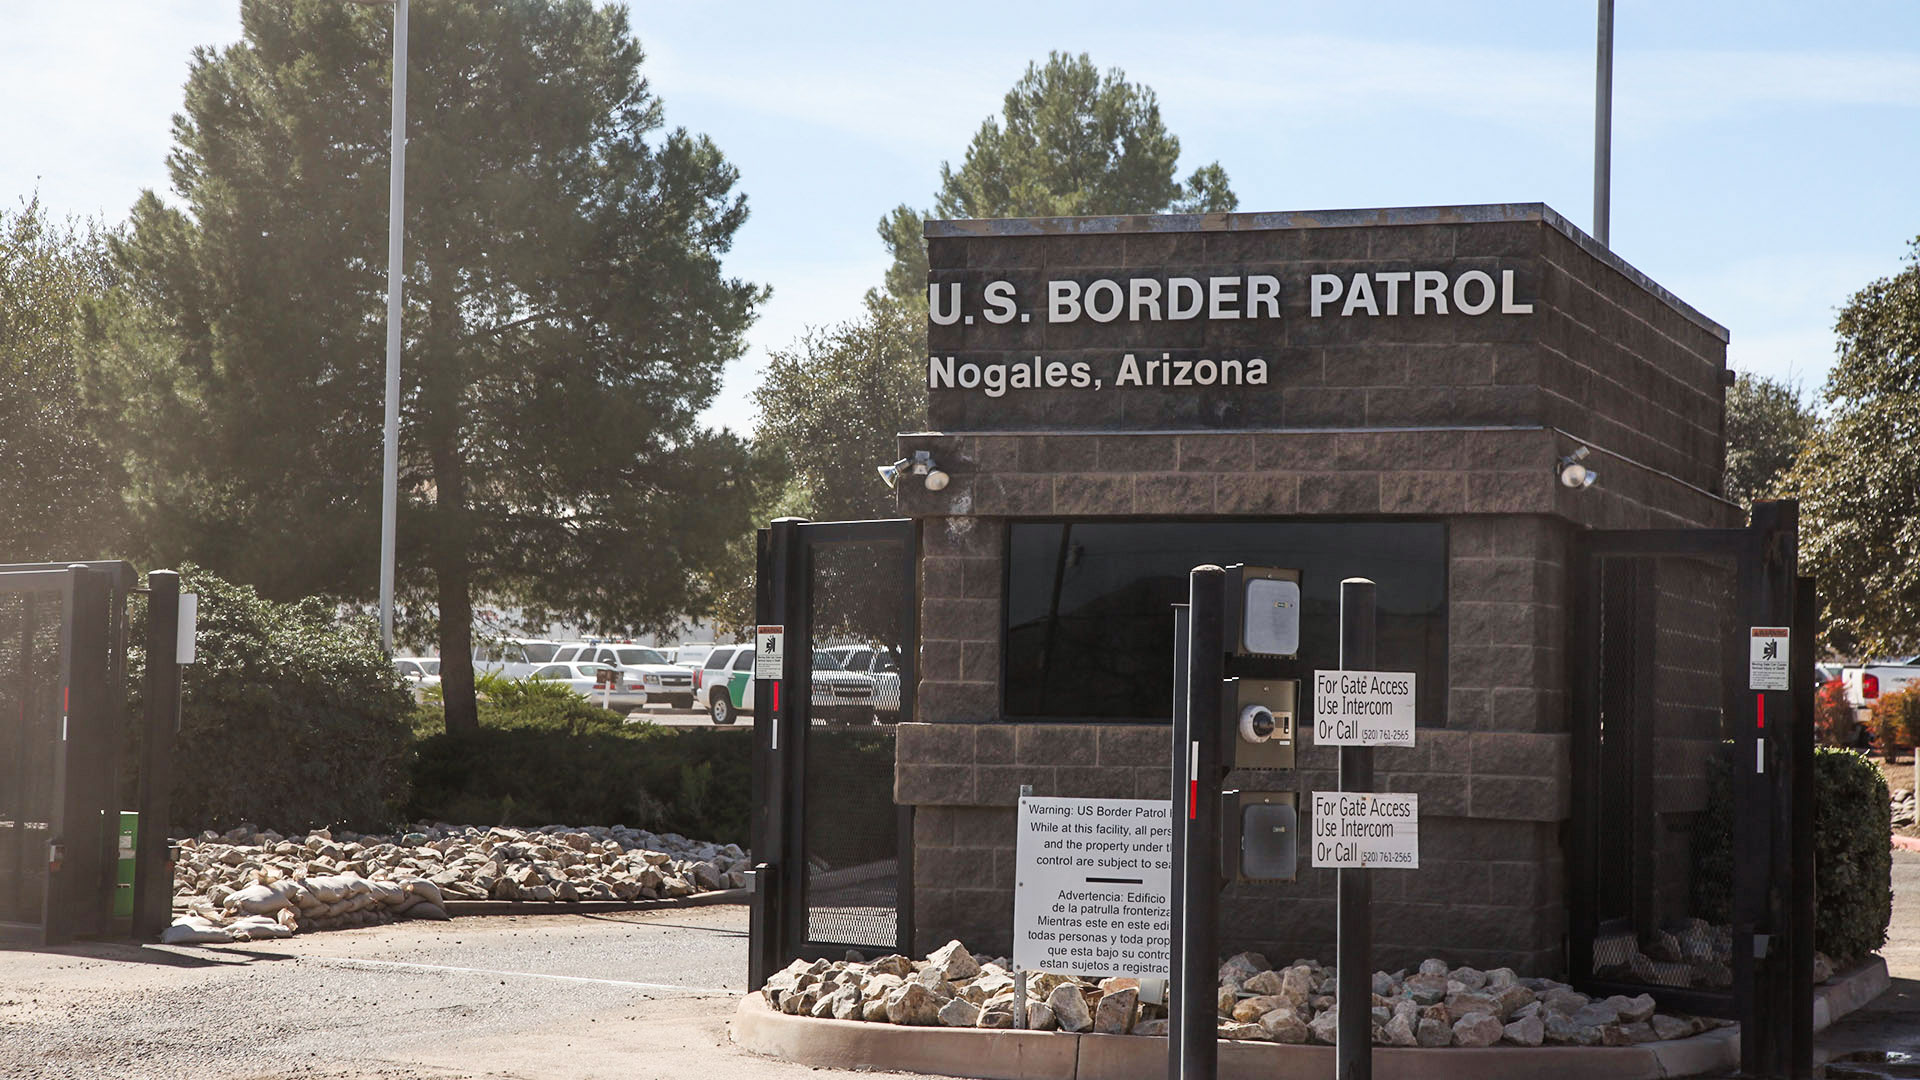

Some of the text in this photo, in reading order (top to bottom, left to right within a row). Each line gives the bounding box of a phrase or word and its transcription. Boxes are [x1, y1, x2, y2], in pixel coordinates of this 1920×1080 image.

[929, 269, 1534, 325] U.S. BORDER PATROL
[929, 353, 1268, 398] Nogales, Arizona
[1318, 675, 1409, 695] For Gate Access
[1318, 696, 1393, 715] Use Intercom
[1319, 720, 1409, 741] Or Call (520) 761-2565
[1028, 804, 1074, 818] Warning:
[1077, 805, 1094, 816] US
[1096, 806, 1133, 817] Border
[1135, 807, 1167, 818] Patrol
[1316, 796, 1411, 817] For Gate Access
[1030, 822, 1059, 833] While
[1061, 824, 1072, 833] at
[1074, 823, 1093, 834] this
[1134, 825, 1147, 836] all
[1316, 818, 1394, 837] Use Intercom
[1044, 839, 1063, 849] and
[1066, 839, 1083, 850] the
[1086, 841, 1130, 854] property
[1132, 842, 1163, 853] under
[1317, 842, 1412, 863] Or Call (520) 761-2565
[1036, 856, 1073, 866] control
[1075, 858, 1095, 867] are
[1097, 857, 1138, 870] subject
[1141, 859, 1152, 869] to
[1058, 889, 1166, 904] Advertencia: Edificio
[1052, 903, 1065, 913] de
[1068, 903, 1078, 914] la
[1081, 904, 1120, 916] patrulla
[1037, 915, 1170, 931] Mientras este en este edi
[1028, 930, 1171, 948] todas personas y toda prop
[1047, 946, 1068, 958] que
[1070, 947, 1093, 957] esta
[1096, 947, 1119, 960] bajo
[1122, 950, 1135, 959] su
[1039, 959, 1069, 969] estan
[1071, 959, 1110, 972] sujetos
[1112, 963, 1119, 971] a
